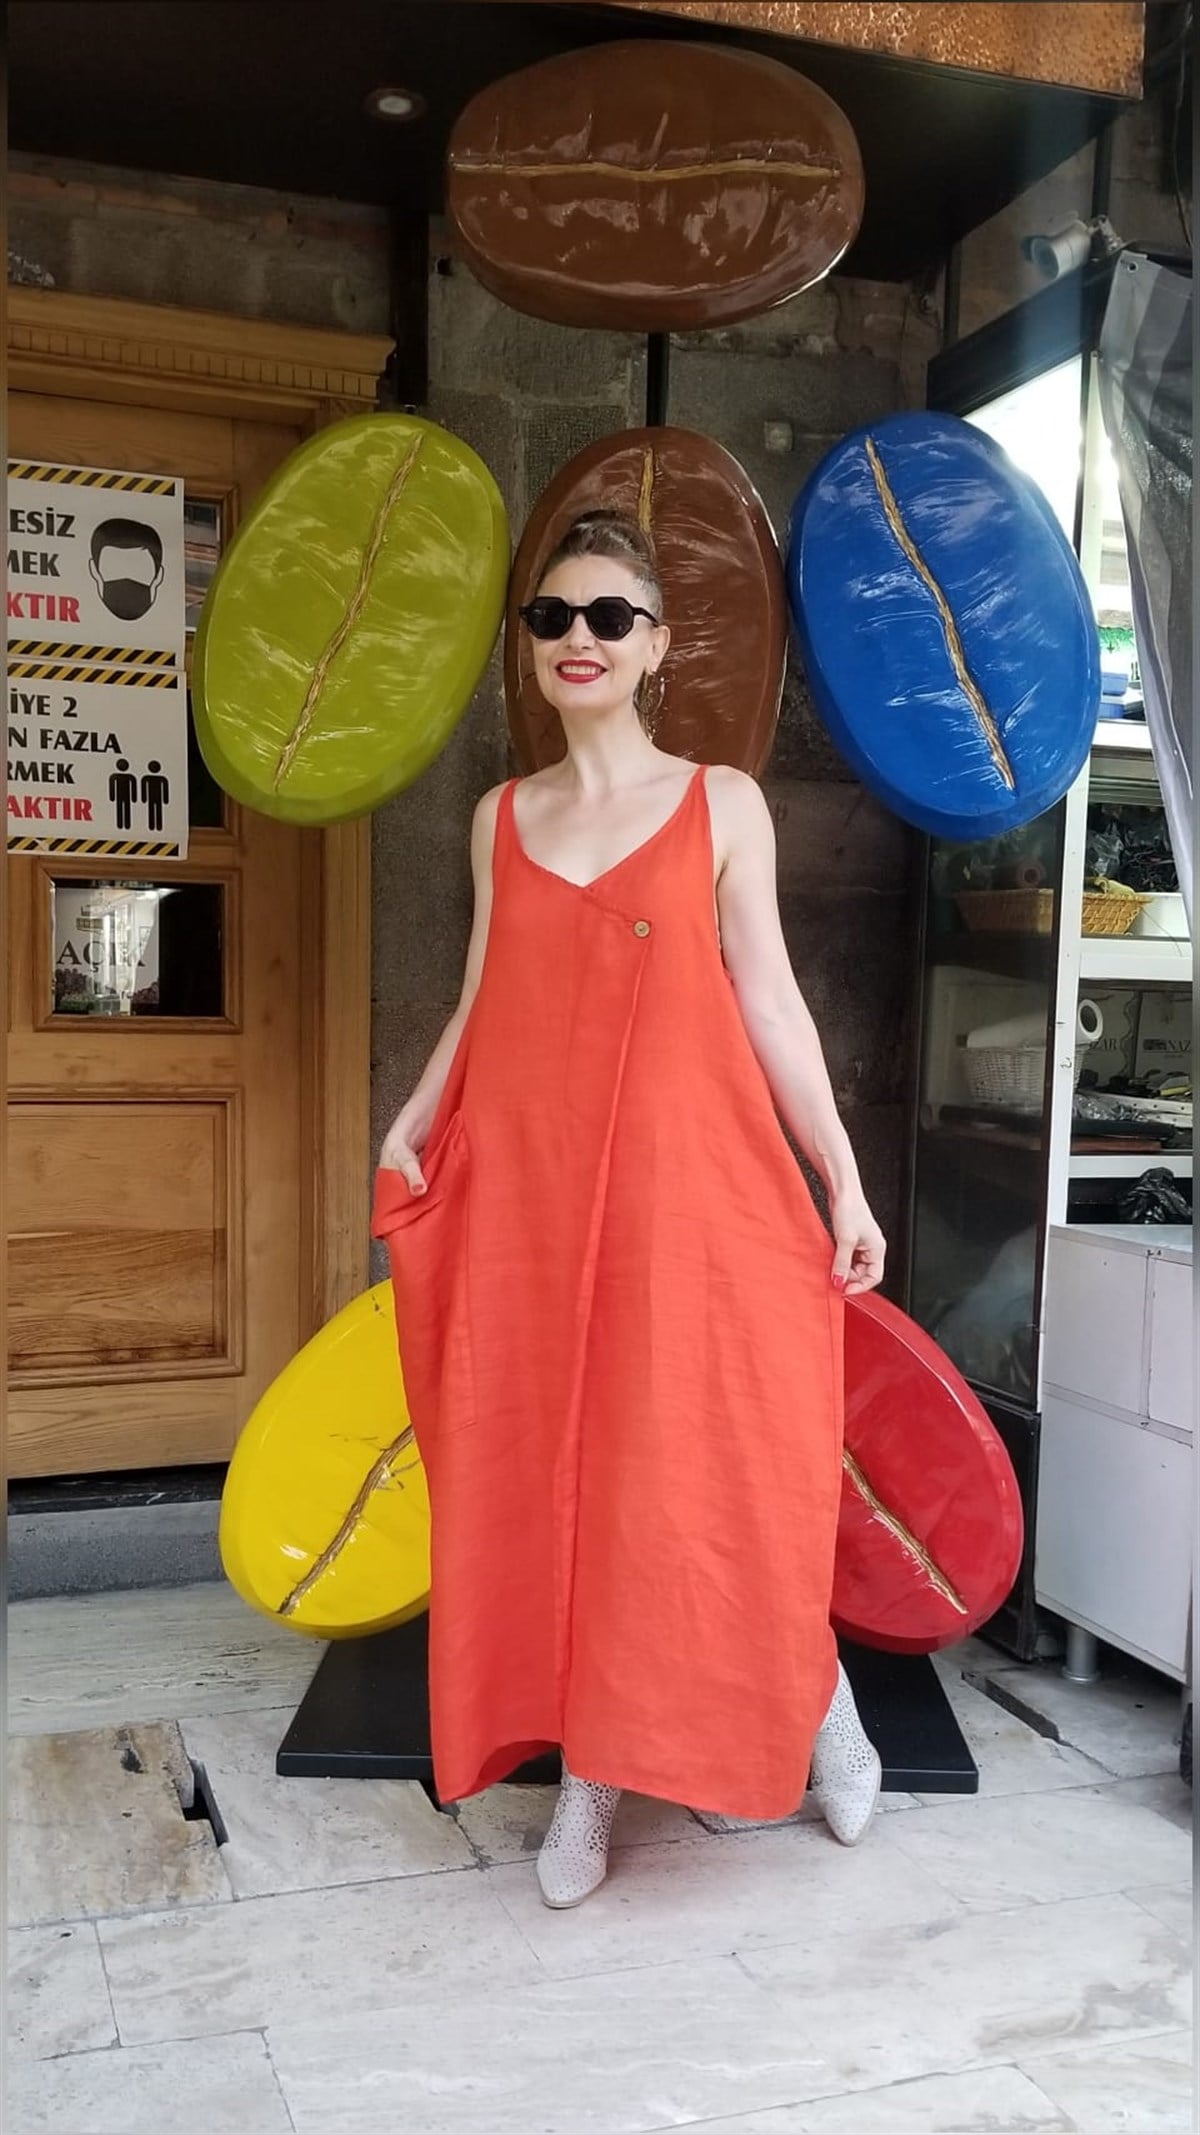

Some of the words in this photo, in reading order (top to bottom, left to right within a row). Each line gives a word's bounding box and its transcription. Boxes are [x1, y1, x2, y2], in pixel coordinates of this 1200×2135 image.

[9, 507, 76, 538] ESİZ
[62, 696, 78, 718] 2
[39, 728, 122, 754] FAZLA
